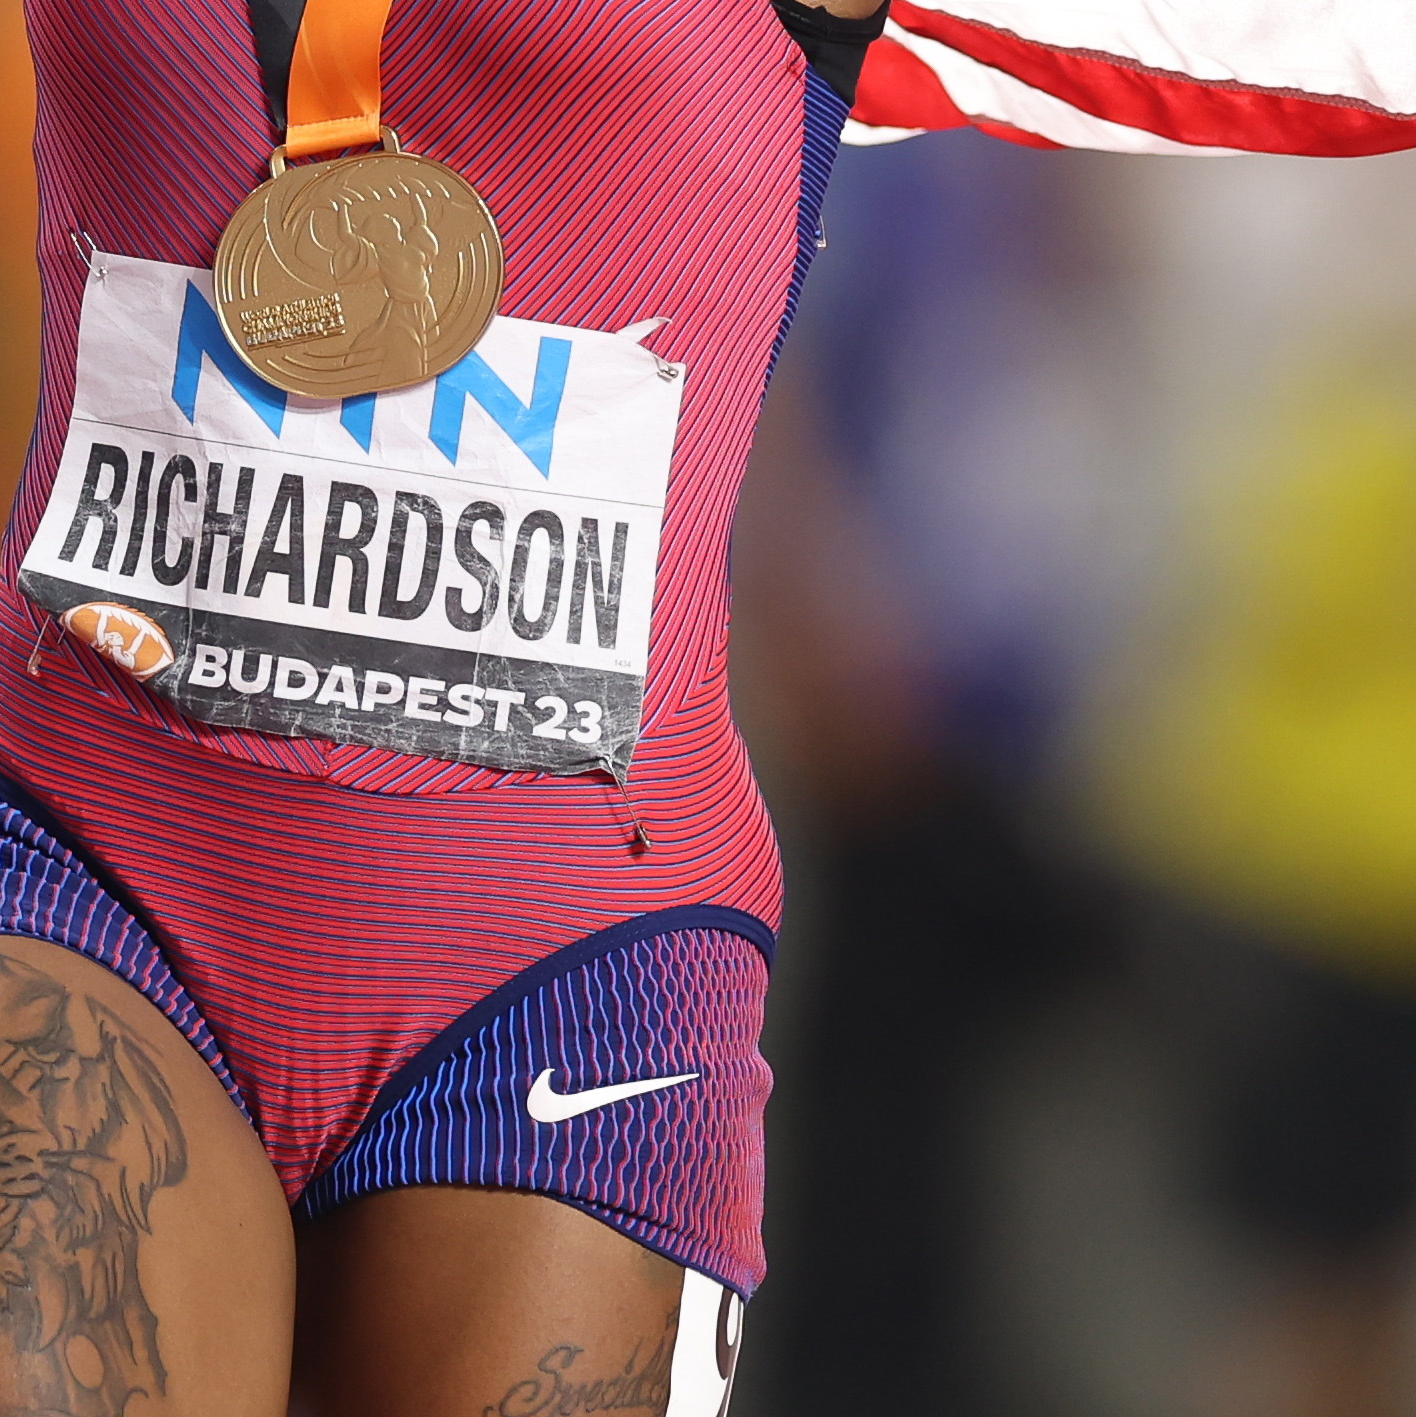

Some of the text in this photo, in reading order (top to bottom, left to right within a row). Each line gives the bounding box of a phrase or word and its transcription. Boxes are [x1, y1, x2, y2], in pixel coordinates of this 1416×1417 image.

[171, 277, 573, 481] NN
[57, 441, 629, 650] RICHARDSON
[187, 643, 603, 744] BUDAPEST 23
